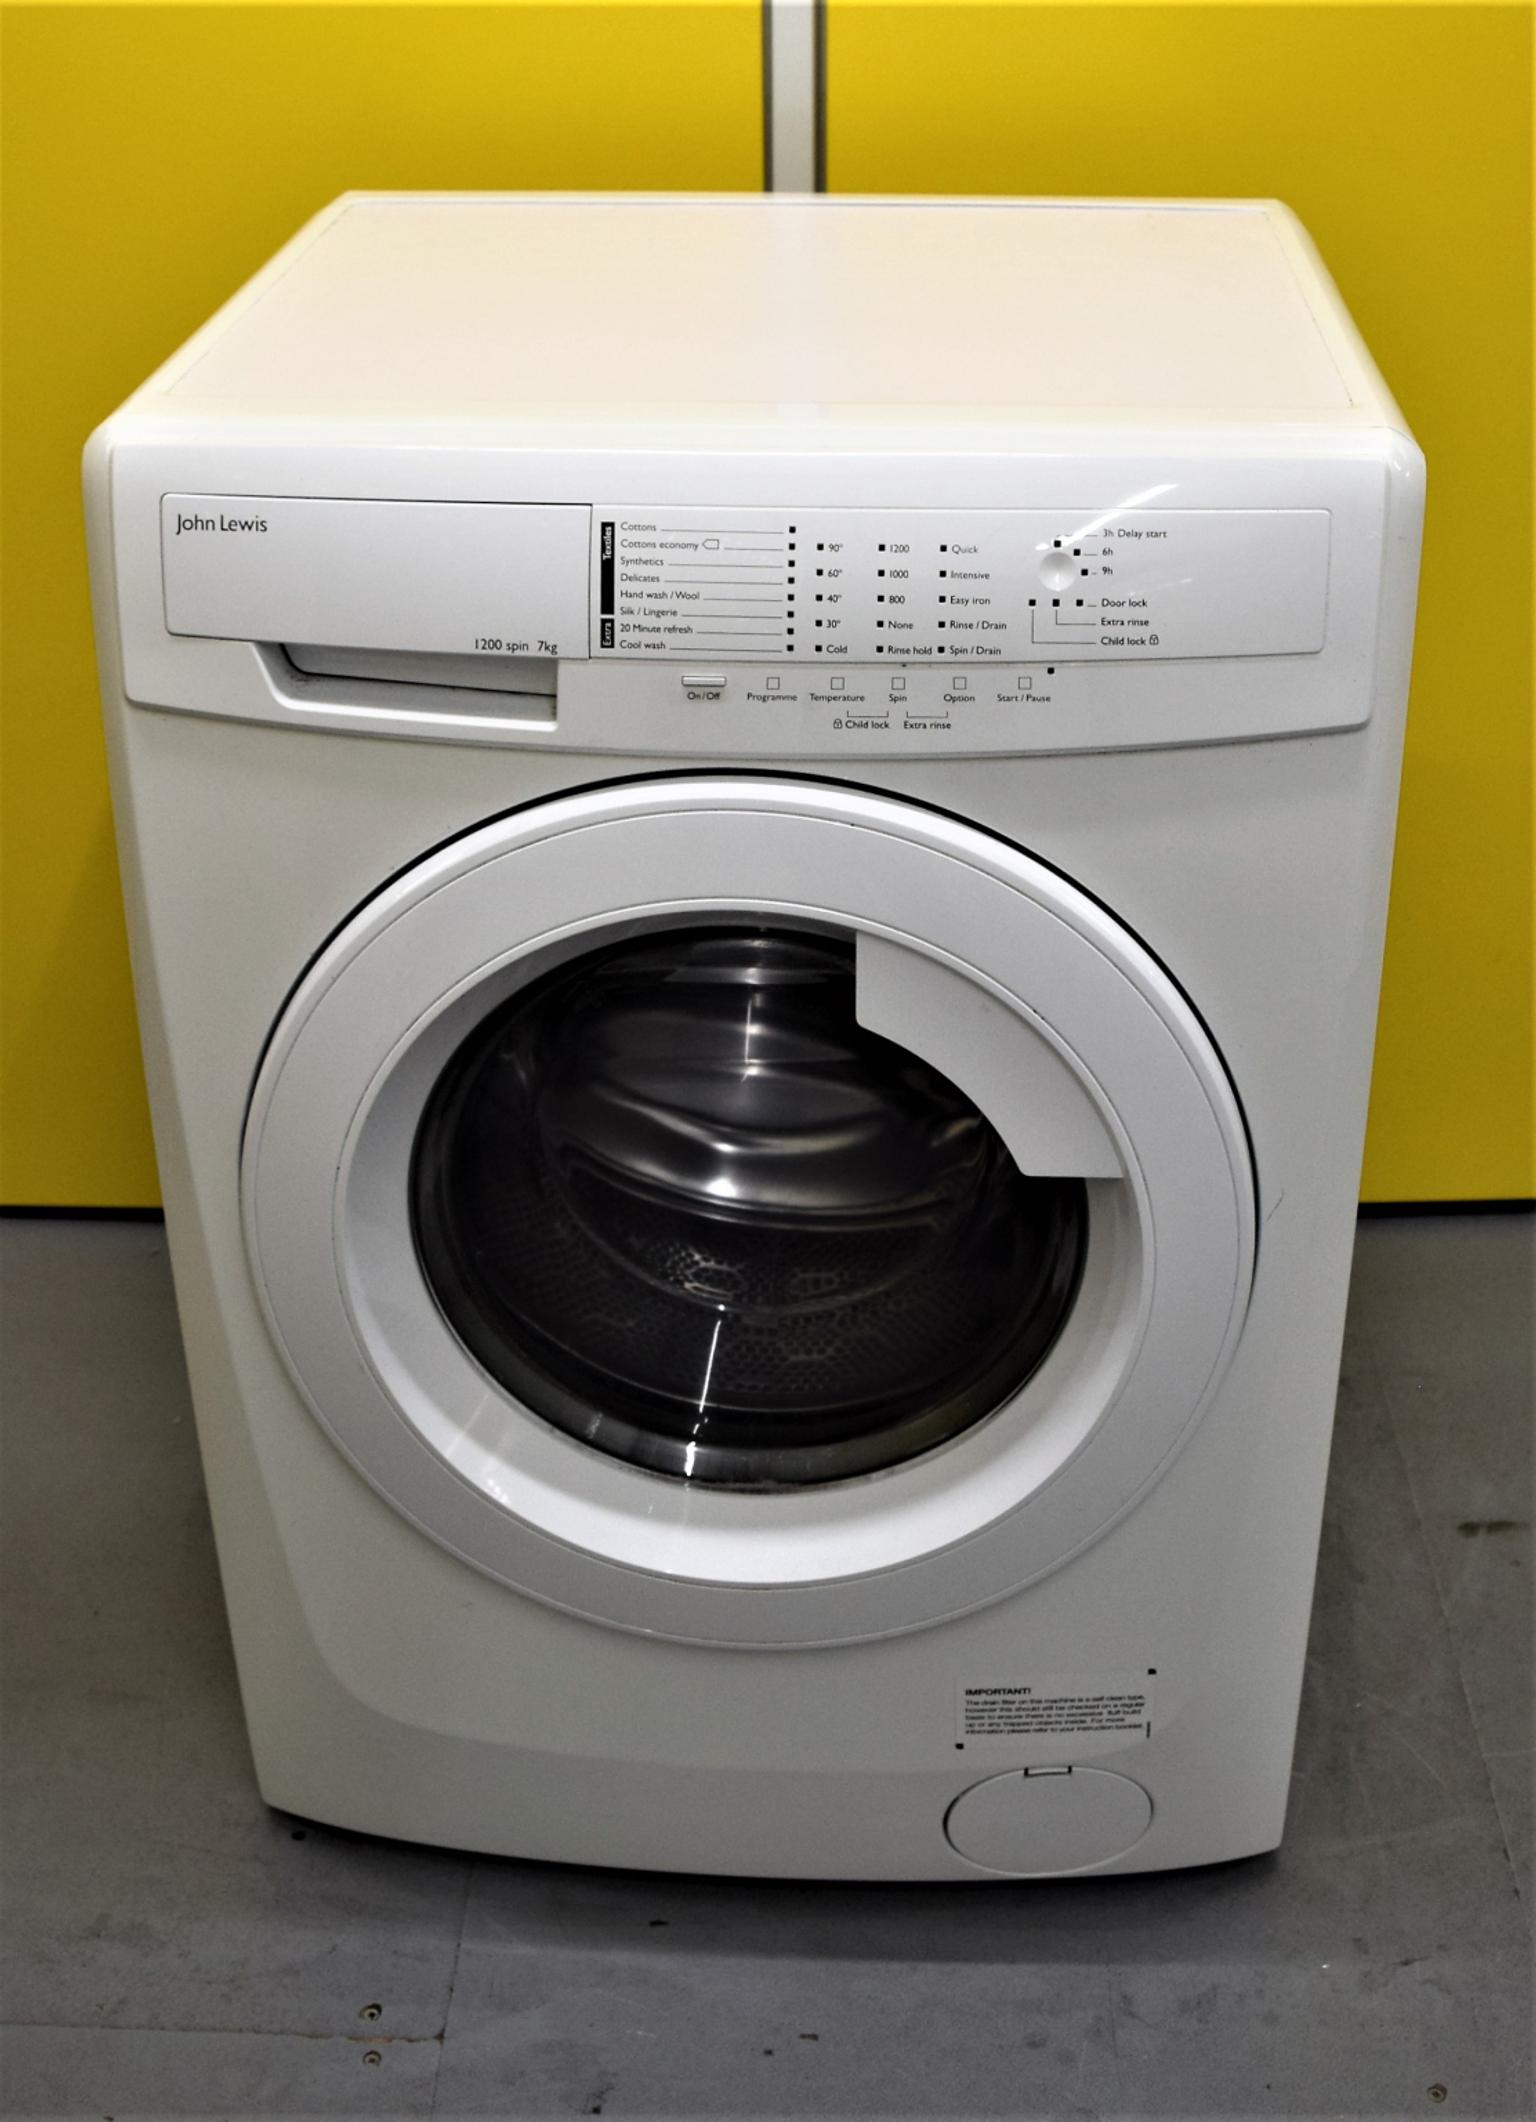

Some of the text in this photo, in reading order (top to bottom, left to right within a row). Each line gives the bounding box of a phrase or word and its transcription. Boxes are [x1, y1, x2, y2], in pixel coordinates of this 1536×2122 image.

[176, 513, 268, 535] John Lewis
[620, 522, 657, 532] Cottons
[1103, 529, 1168, 539] 3h Delay start
[602, 526, 613, 561] Textiles
[620, 539, 699, 552] Cottons economy
[890, 544, 910, 553] 1200
[951, 544, 979, 554] Quick
[1102, 548, 1113, 556] 6h
[620, 557, 664, 567] Synthetics
[889, 569, 909, 578] 1000
[950, 570, 990, 580] Intensive
[1102, 567, 1113, 575] 9h
[620, 573, 660, 583] Delicates
[620, 590, 644, 599] Hand
[646, 591, 669, 600] wash
[675, 591, 700, 600] Wool
[889, 595, 905, 604] 800
[950, 596, 991, 606] Easy iron
[1101, 598, 1148, 607] Door lock
[620, 607, 635, 616] Silk
[643, 607, 678, 618] Lingerie
[888, 620, 914, 630] None
[950, 620, 974, 630] Rinse
[981, 621, 1007, 630] Drain
[1101, 617, 1149, 626] Extra rinse
[602, 622, 613, 646] Extra
[619, 624, 694, 634] 20 Minute refresh
[619, 640, 666, 650] Cool wash
[1101, 636, 1146, 646] Child lock
[475, 638, 558, 656] 1200 spin 7kg
[826, 645, 848, 654] Cold
[888, 645, 932, 655] Rinse hold
[950, 645, 968, 656] Spin
[976, 646, 1001, 655] Drain
[747, 693, 798, 703] Programme
[809, 693, 865, 703] Temperature
[889, 693, 908, 704] Spin
[943, 693, 976, 703] Option
[996, 693, 1018, 702] Start
[1026, 694, 1051, 702] Pause
[845, 719, 890, 729] Child lock
[904, 720, 952, 729] Extra rinse
[965, 1687, 1032, 1696] IMPORTANT!
